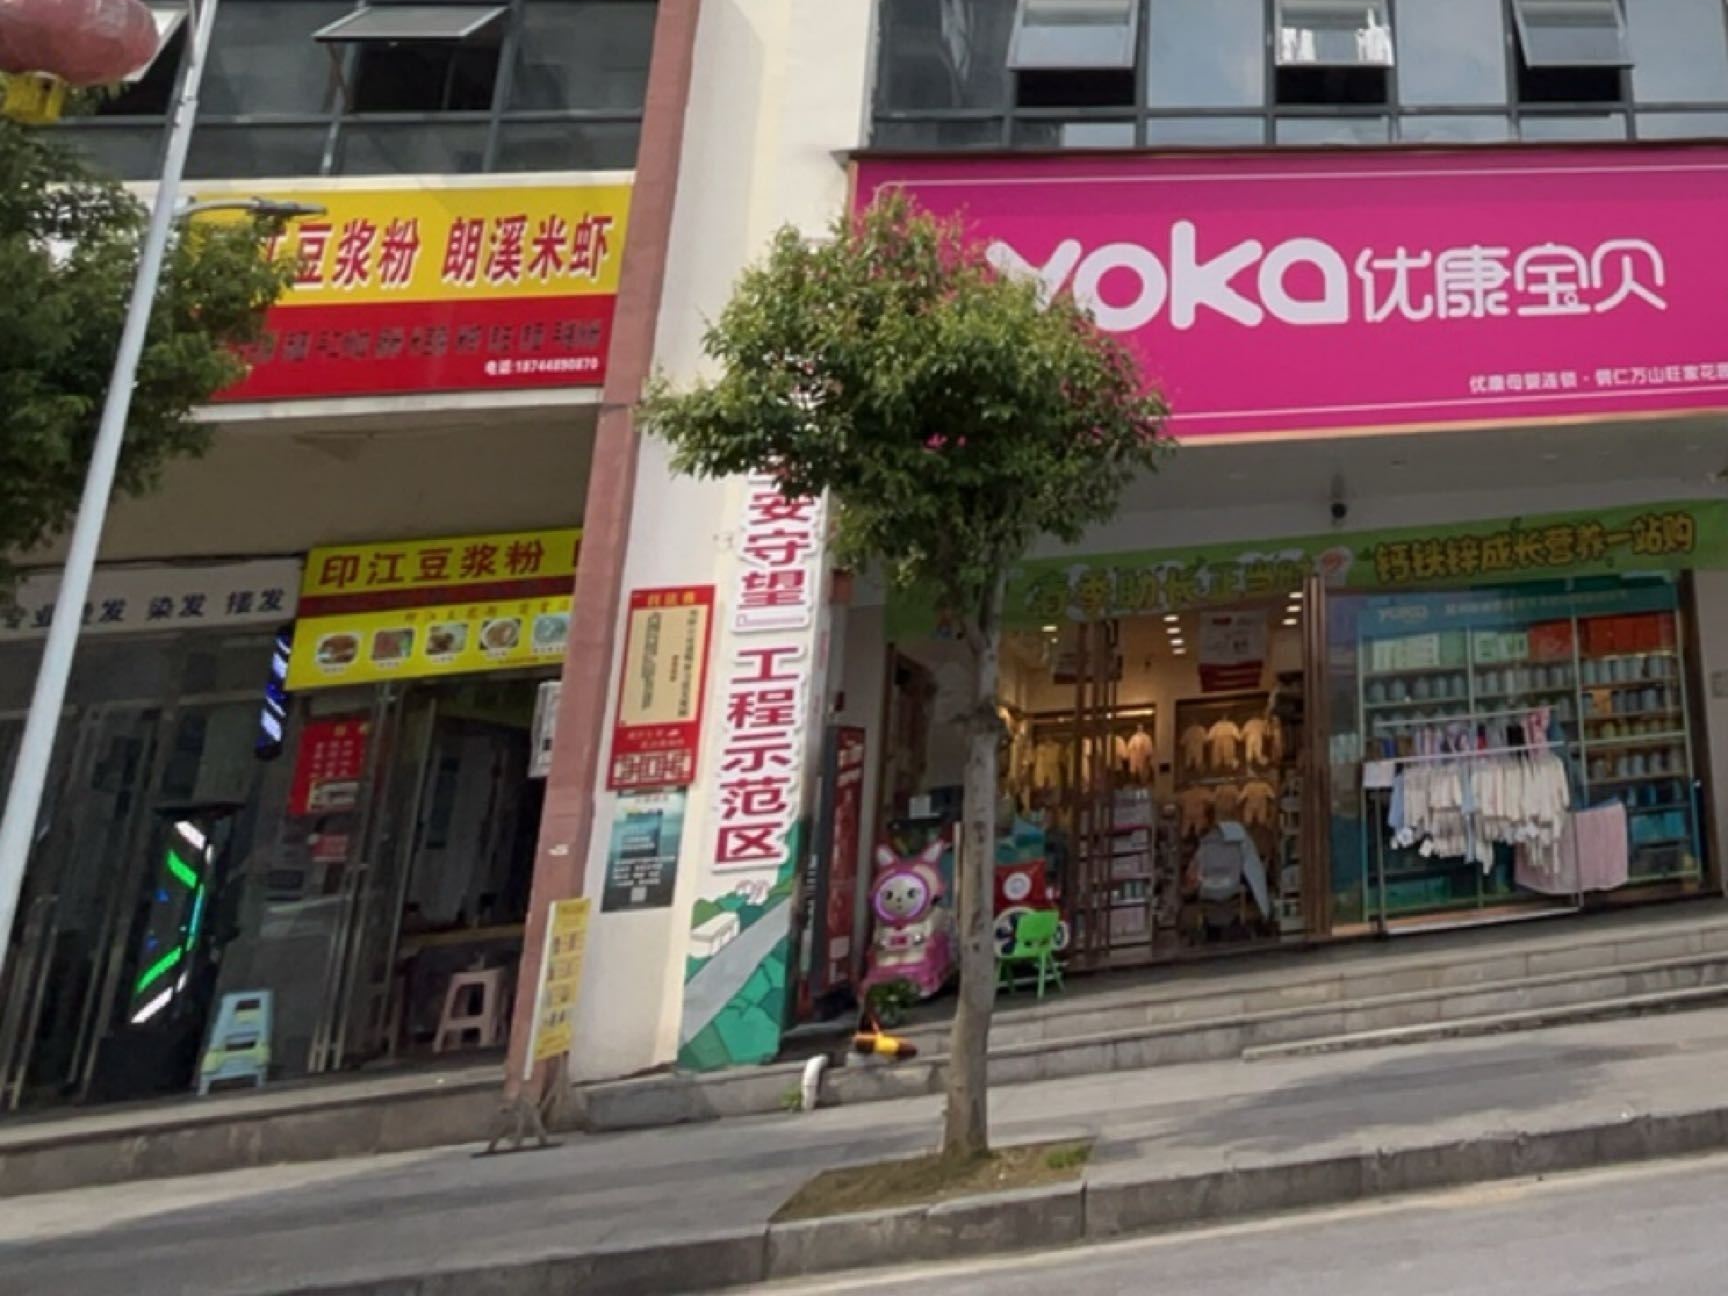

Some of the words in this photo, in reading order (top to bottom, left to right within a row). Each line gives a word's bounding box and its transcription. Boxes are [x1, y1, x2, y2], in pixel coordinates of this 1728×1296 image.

[442, 212, 614, 288] 朗溪米虾
[1355, 238, 1668, 321] 优康宝贝
[319, 539, 545, 588] 印江豆浆粉
[146, 593, 206, 622] 染发
